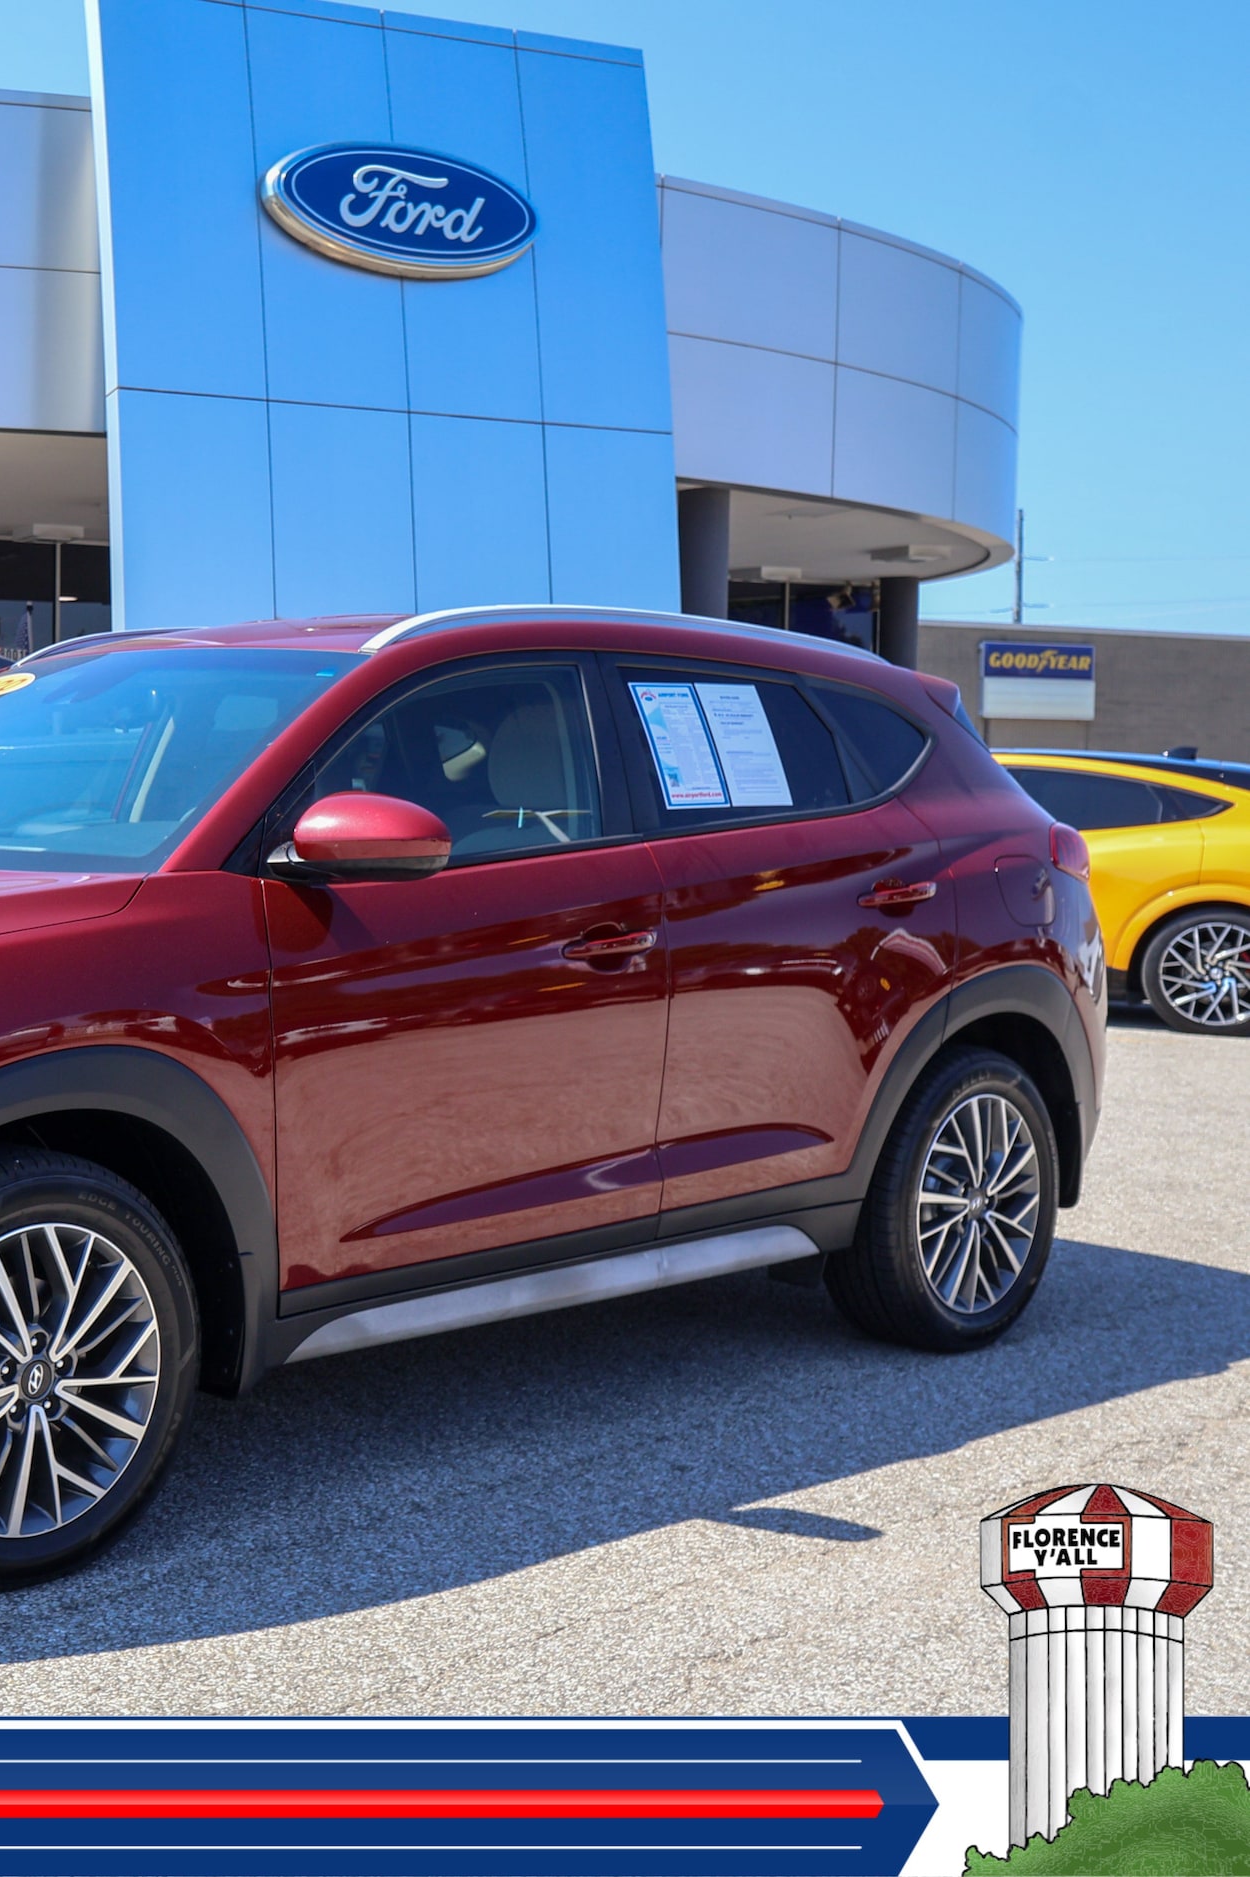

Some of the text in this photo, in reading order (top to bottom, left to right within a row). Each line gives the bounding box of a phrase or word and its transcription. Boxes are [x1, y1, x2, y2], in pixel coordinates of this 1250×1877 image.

[339, 164, 486, 243] Ford
[989, 649, 1092, 673] GOODYEAR
[77, 1191, 117, 1211] EDGE
[125, 1212, 171, 1266] TOURING
